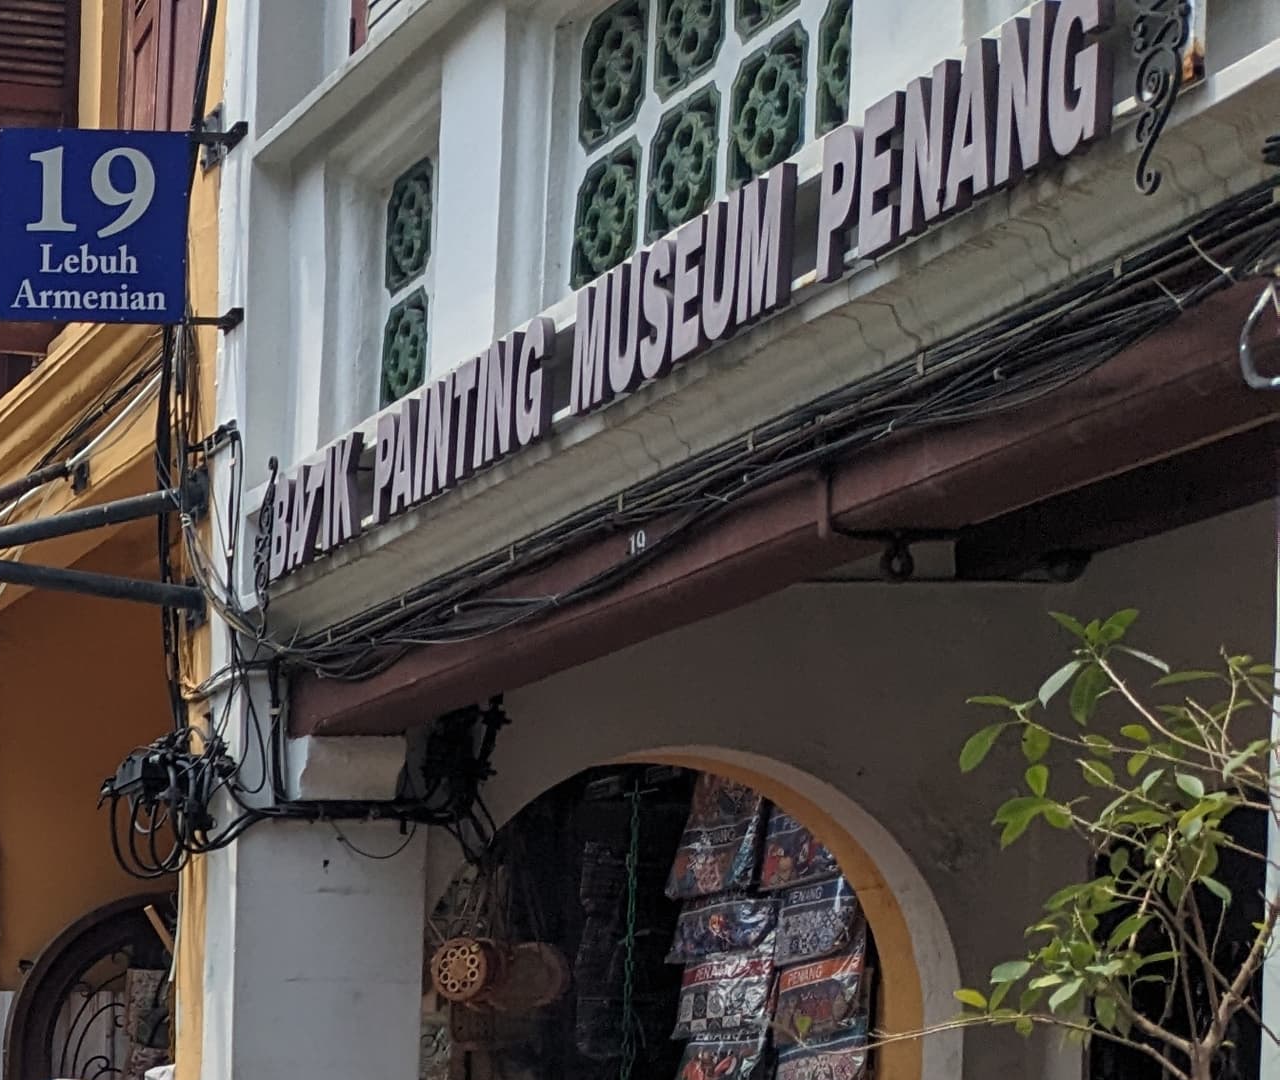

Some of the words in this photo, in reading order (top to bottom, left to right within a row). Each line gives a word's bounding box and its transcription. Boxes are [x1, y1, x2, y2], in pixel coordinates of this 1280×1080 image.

[26, 146, 155, 238] 19
[40, 244, 138, 274] Lebuh
[269, 432, 364, 580] BATIK
[372, 316, 555, 523] PAINTING
[570, 162, 797, 414] MUSEUM
[815, 0, 1113, 283] PENANG
[10, 279, 167, 311] Armenian
